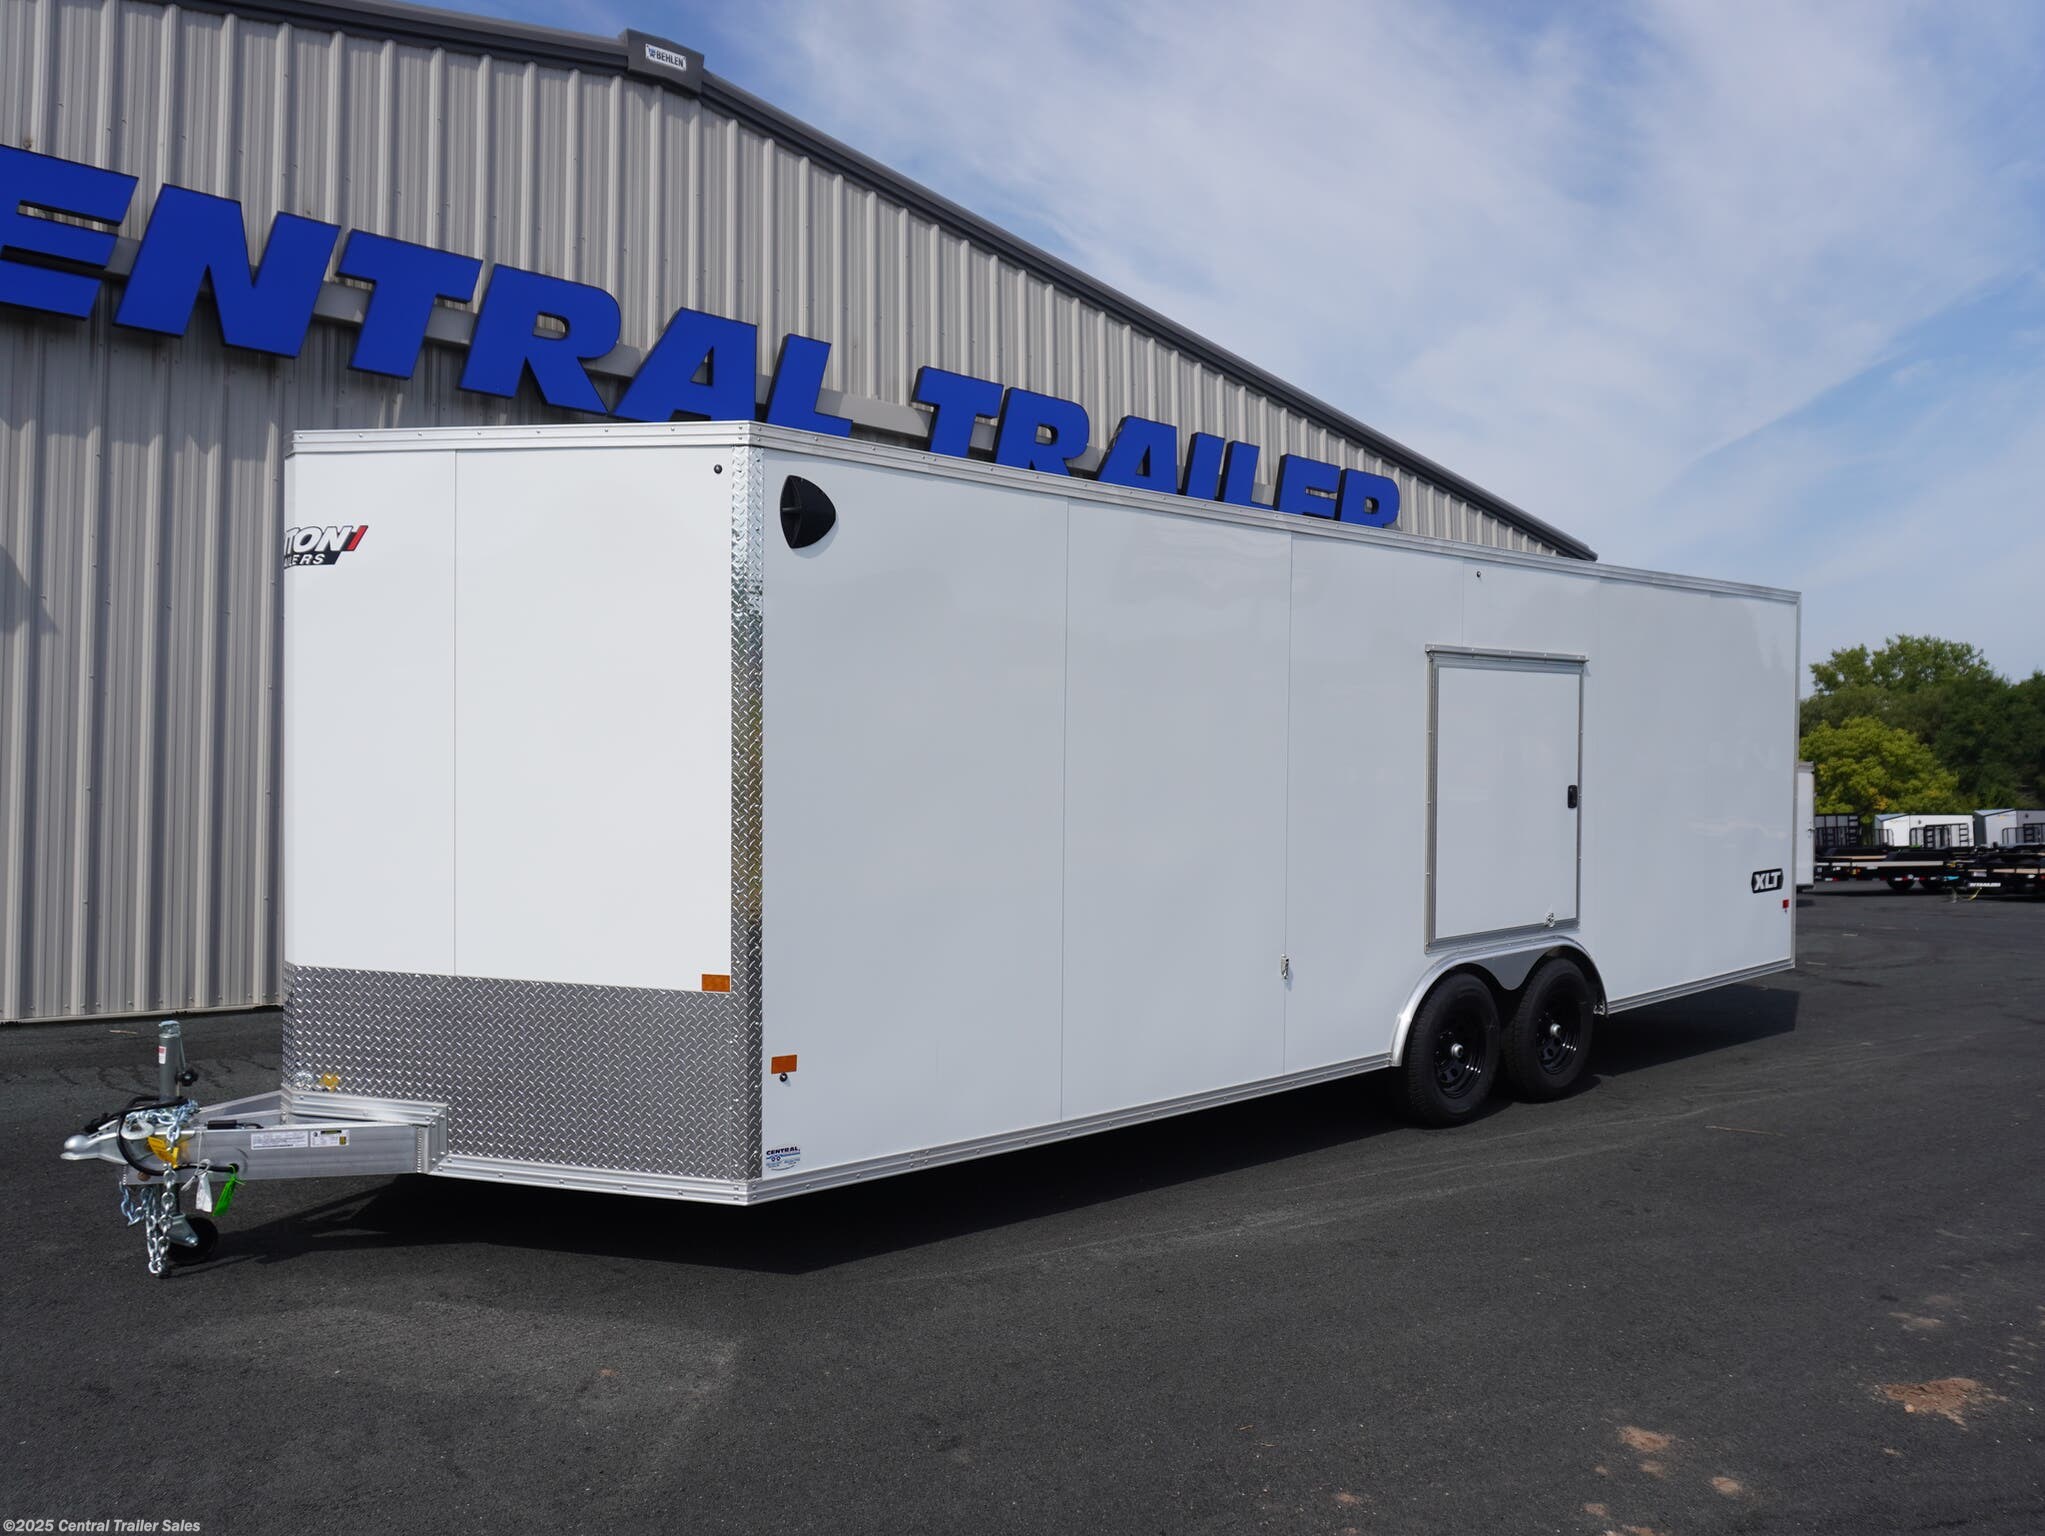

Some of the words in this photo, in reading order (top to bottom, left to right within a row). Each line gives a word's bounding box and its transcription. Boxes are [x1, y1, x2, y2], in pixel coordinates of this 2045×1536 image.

[656, 50, 684, 68] BEHLEN
[1753, 871, 1782, 891] XLT
[766, 1146, 799, 1156] CENTRAL
